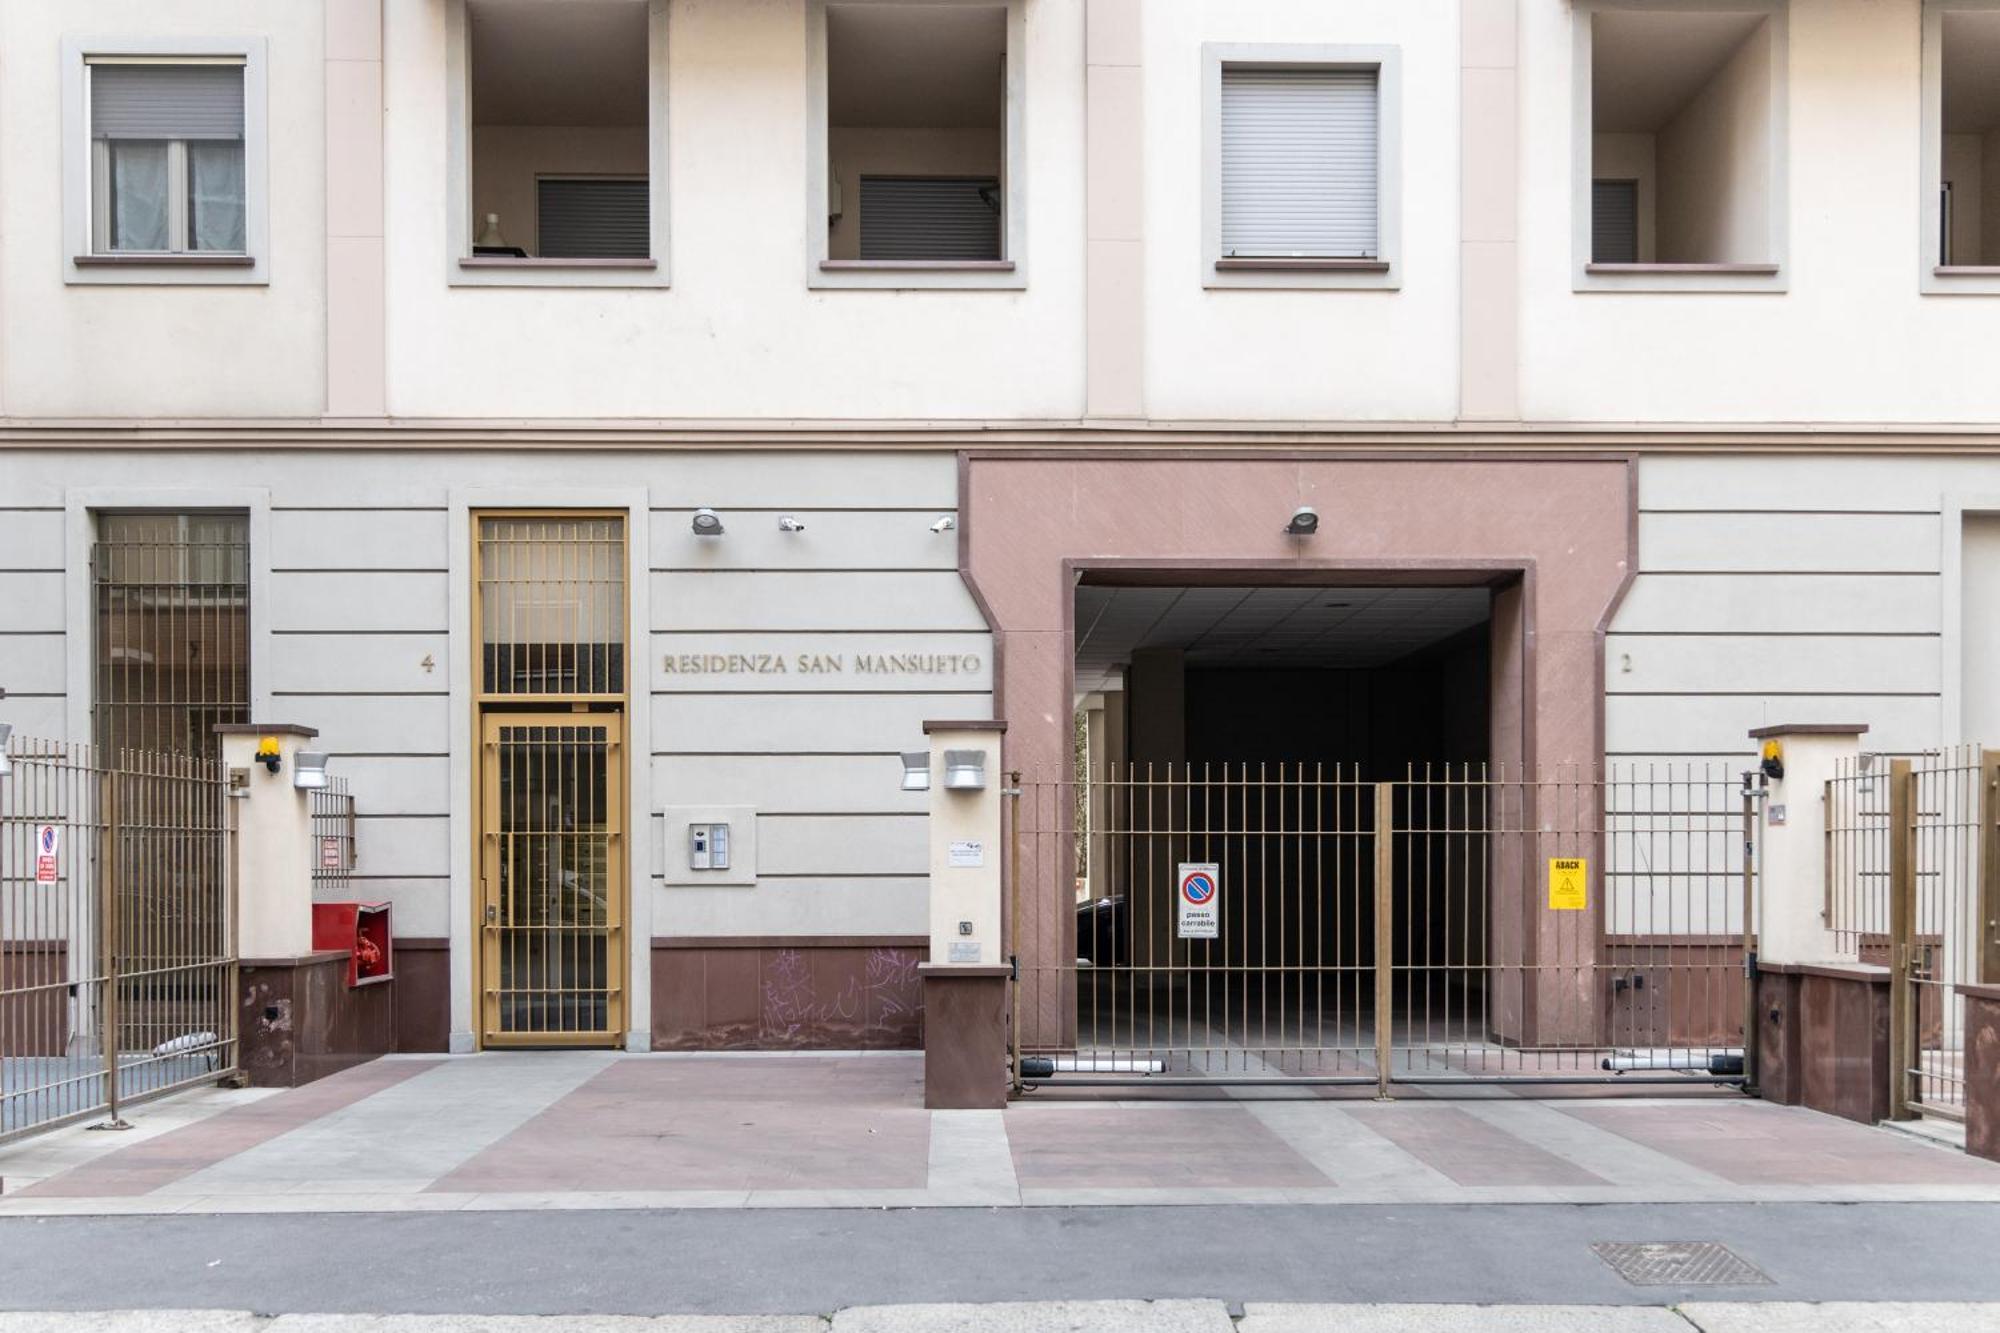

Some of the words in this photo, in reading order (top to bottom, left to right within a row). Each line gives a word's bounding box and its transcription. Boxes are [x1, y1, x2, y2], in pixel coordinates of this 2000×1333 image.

[420, 653, 435, 674] 4
[663, 653, 787, 674] RESIDENZA
[797, 653, 843, 674] SAN
[855, 653, 981, 674] MANSUETO
[1621, 653, 1633, 674] 2
[1181, 918, 1216, 927] carrabile
[1186, 911, 1210, 919] passo
